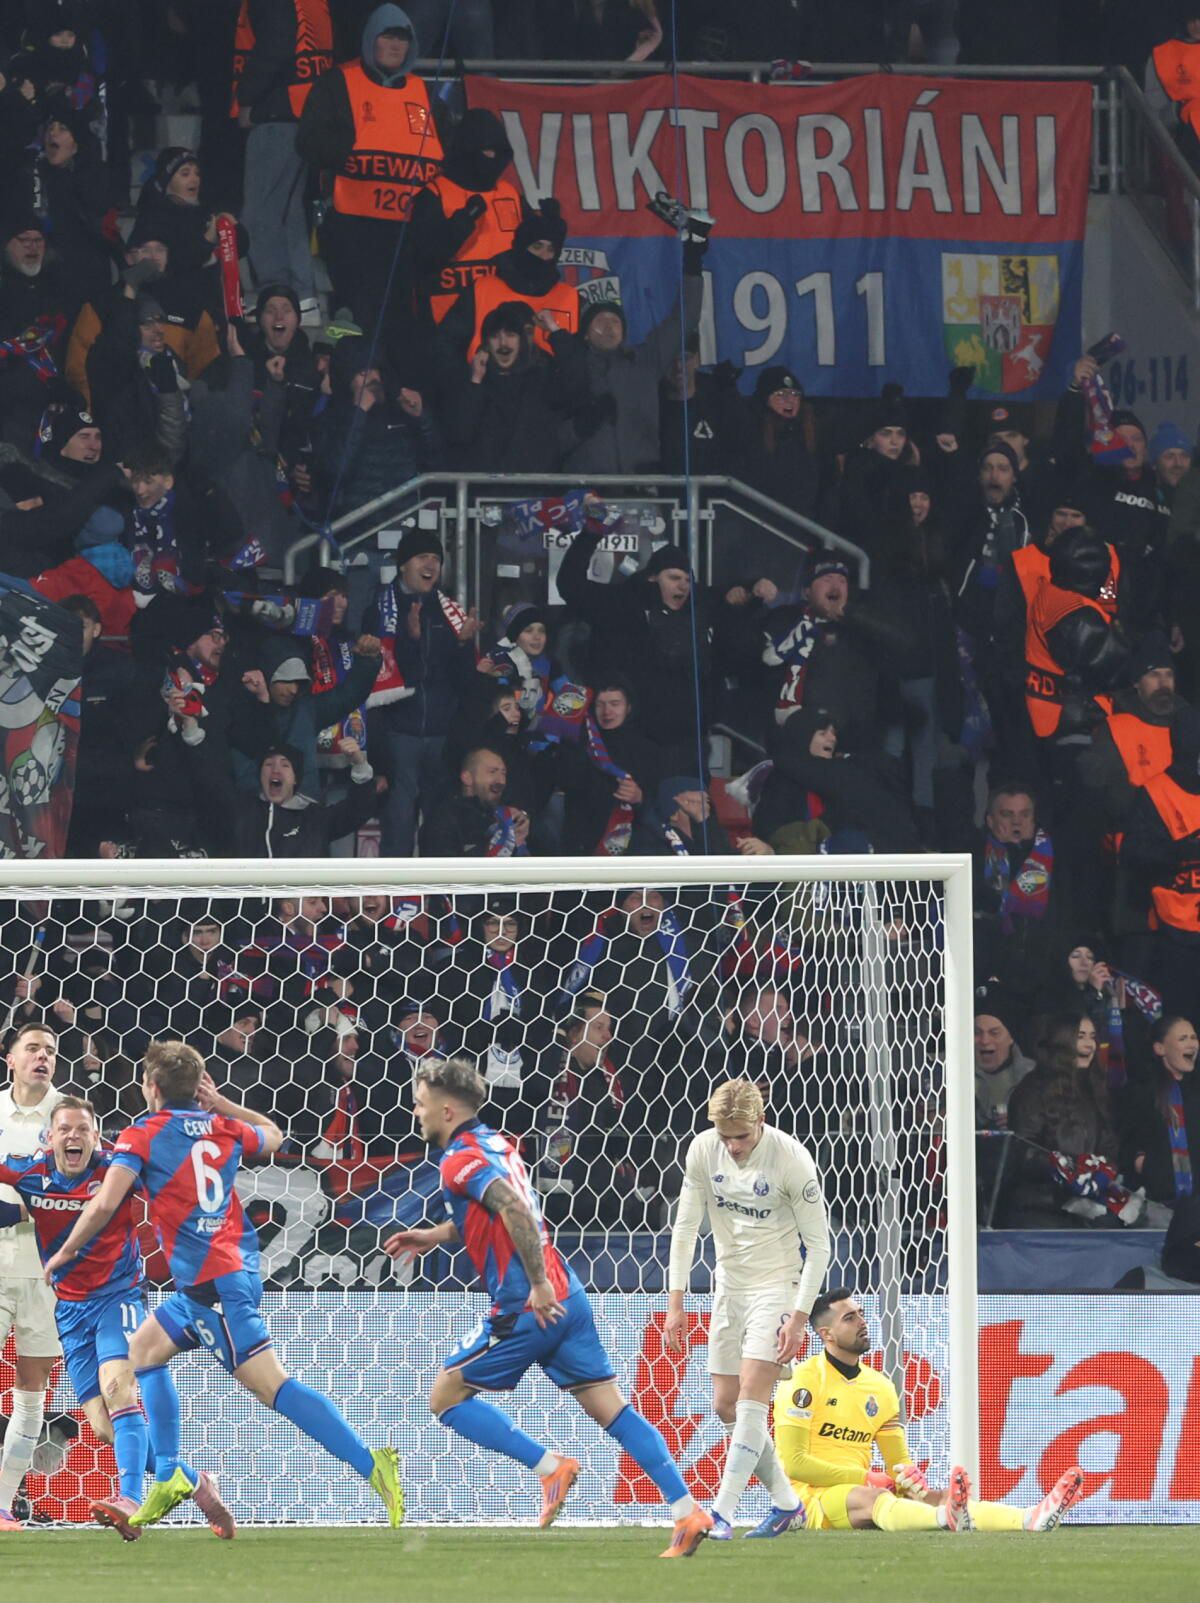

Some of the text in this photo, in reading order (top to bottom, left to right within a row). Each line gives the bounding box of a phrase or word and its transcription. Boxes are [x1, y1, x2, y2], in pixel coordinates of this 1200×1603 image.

[501, 88, 1058, 215] VIKTORIÁNI
[344, 155, 442, 182] STEWAR
[702, 271, 885, 366] 1911
[190, 1139, 225, 1213] 6
[120, 1303, 137, 1330] 11
[195, 1319, 215, 1346] 6
[818, 1422, 872, 1443] Betano
